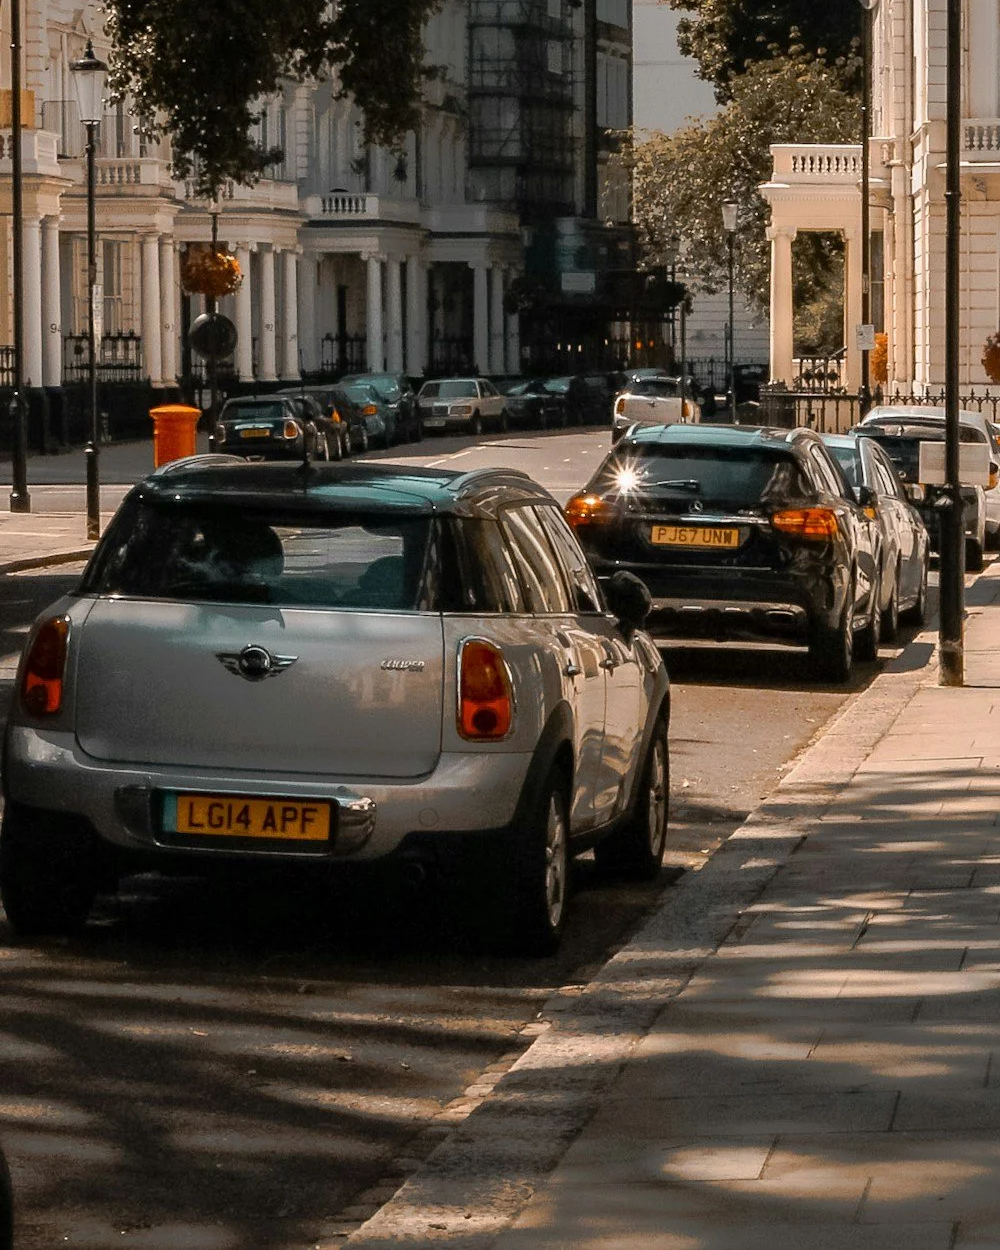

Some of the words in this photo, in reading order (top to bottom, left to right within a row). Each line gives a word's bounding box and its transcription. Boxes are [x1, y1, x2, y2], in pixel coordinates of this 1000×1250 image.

[657, 527, 698, 542] PJ67
[702, 529, 733, 544] UNW
[187, 801, 252, 830] LG14
[262, 805, 318, 834] APF
